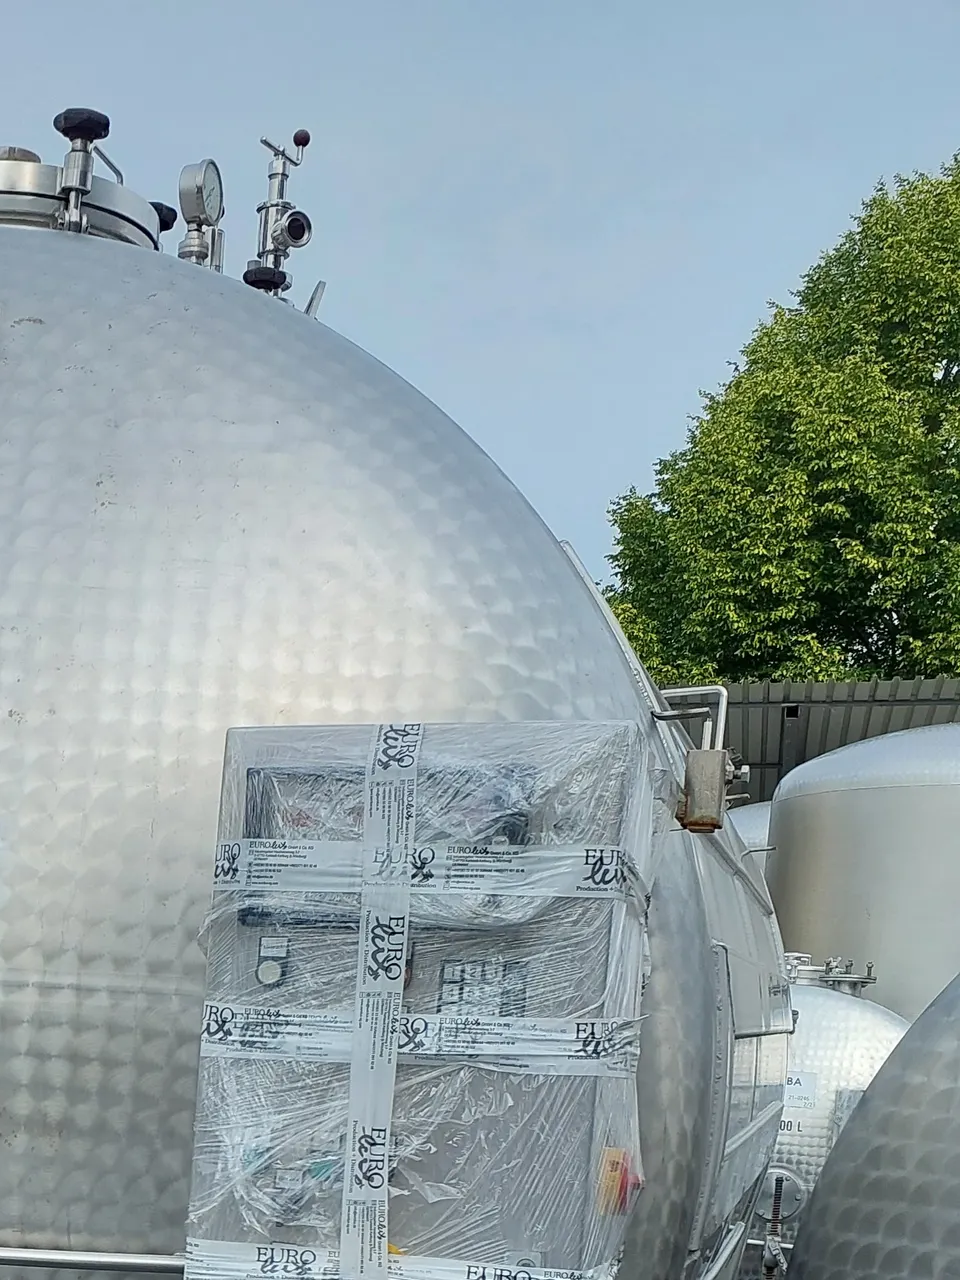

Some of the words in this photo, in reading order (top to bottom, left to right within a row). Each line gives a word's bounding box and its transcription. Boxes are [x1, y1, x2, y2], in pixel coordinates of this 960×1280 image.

[384, 915, 406, 981] EURO
[797, 1121, 803, 1132] L
[367, 1127, 387, 1189] EURO
[255, 1246, 316, 1264] EURO
